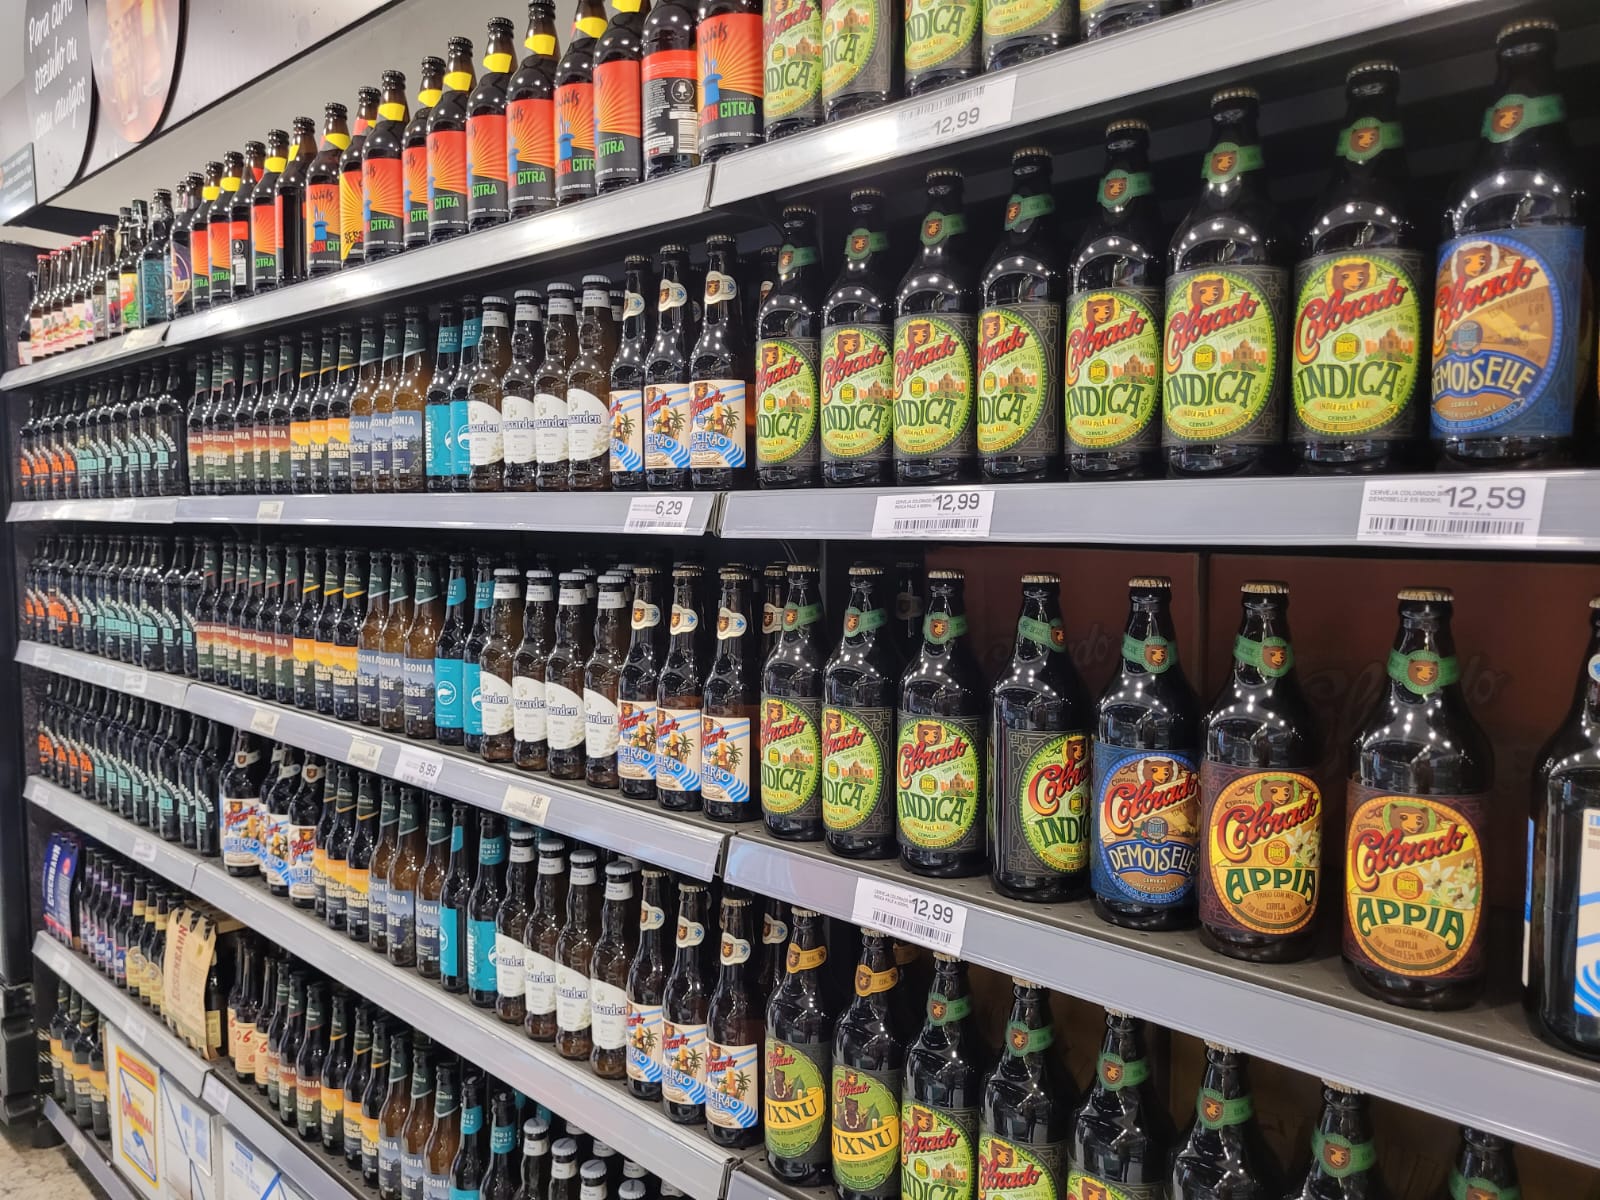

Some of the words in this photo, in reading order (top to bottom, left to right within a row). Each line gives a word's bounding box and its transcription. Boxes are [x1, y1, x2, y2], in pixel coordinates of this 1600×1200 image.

[29, 11, 50, 54] Para
[35, 35, 65, 95] sozinho
[66, 36, 78, 64] ou
[54, 76, 85, 129] amigos
[719, 101, 756, 118] CITRA
[933, 107, 981, 136] 12,99
[573, 157, 596, 172] CITR
[599, 141, 625, 158] CITRA
[472, 183, 498, 198] CITRA
[518, 171, 547, 185] CITRA
[410, 210, 428, 223] CITR
[434, 196, 460, 210] CITRA
[344, 231, 363, 244] SESS
[370, 219, 395, 231] CITRA
[327, 239, 341, 252] CIT
[1164, 292, 1260, 374] Colorado
[1296, 278, 1408, 365] Colorado
[1065, 311, 1149, 387] Colorado
[822, 344, 887, 405] Colorado
[894, 334, 959, 400] Colorado
[1298, 361, 1403, 405] INDICA
[1067, 383, 1145, 420] INDICA
[1165, 371, 1256, 411] INDICA
[822, 404, 886, 433] INDICA
[893, 398, 957, 430] INDICA
[1328, 414, 1357, 422] CERVEJA
[655, 500, 683, 517] 6,29
[935, 493, 980, 513] 12,99
[1445, 486, 1527, 512] 12,59
[898, 737, 969, 790] Colorado
[899, 791, 968, 826] INDICA
[1104, 772, 1199, 836] Colorado
[1034, 815, 1092, 849] INDIC
[1217, 791, 1319, 864] Colorado
[1108, 844, 1197, 874] DEMOISELLE
[1352, 823, 1468, 892] Colorado
[1225, 868, 1317, 905] APPIA
[912, 897, 954, 924] 12,99
[1356, 897, 1465, 950] APPIA
[768, 1098, 817, 1124] IXNU
